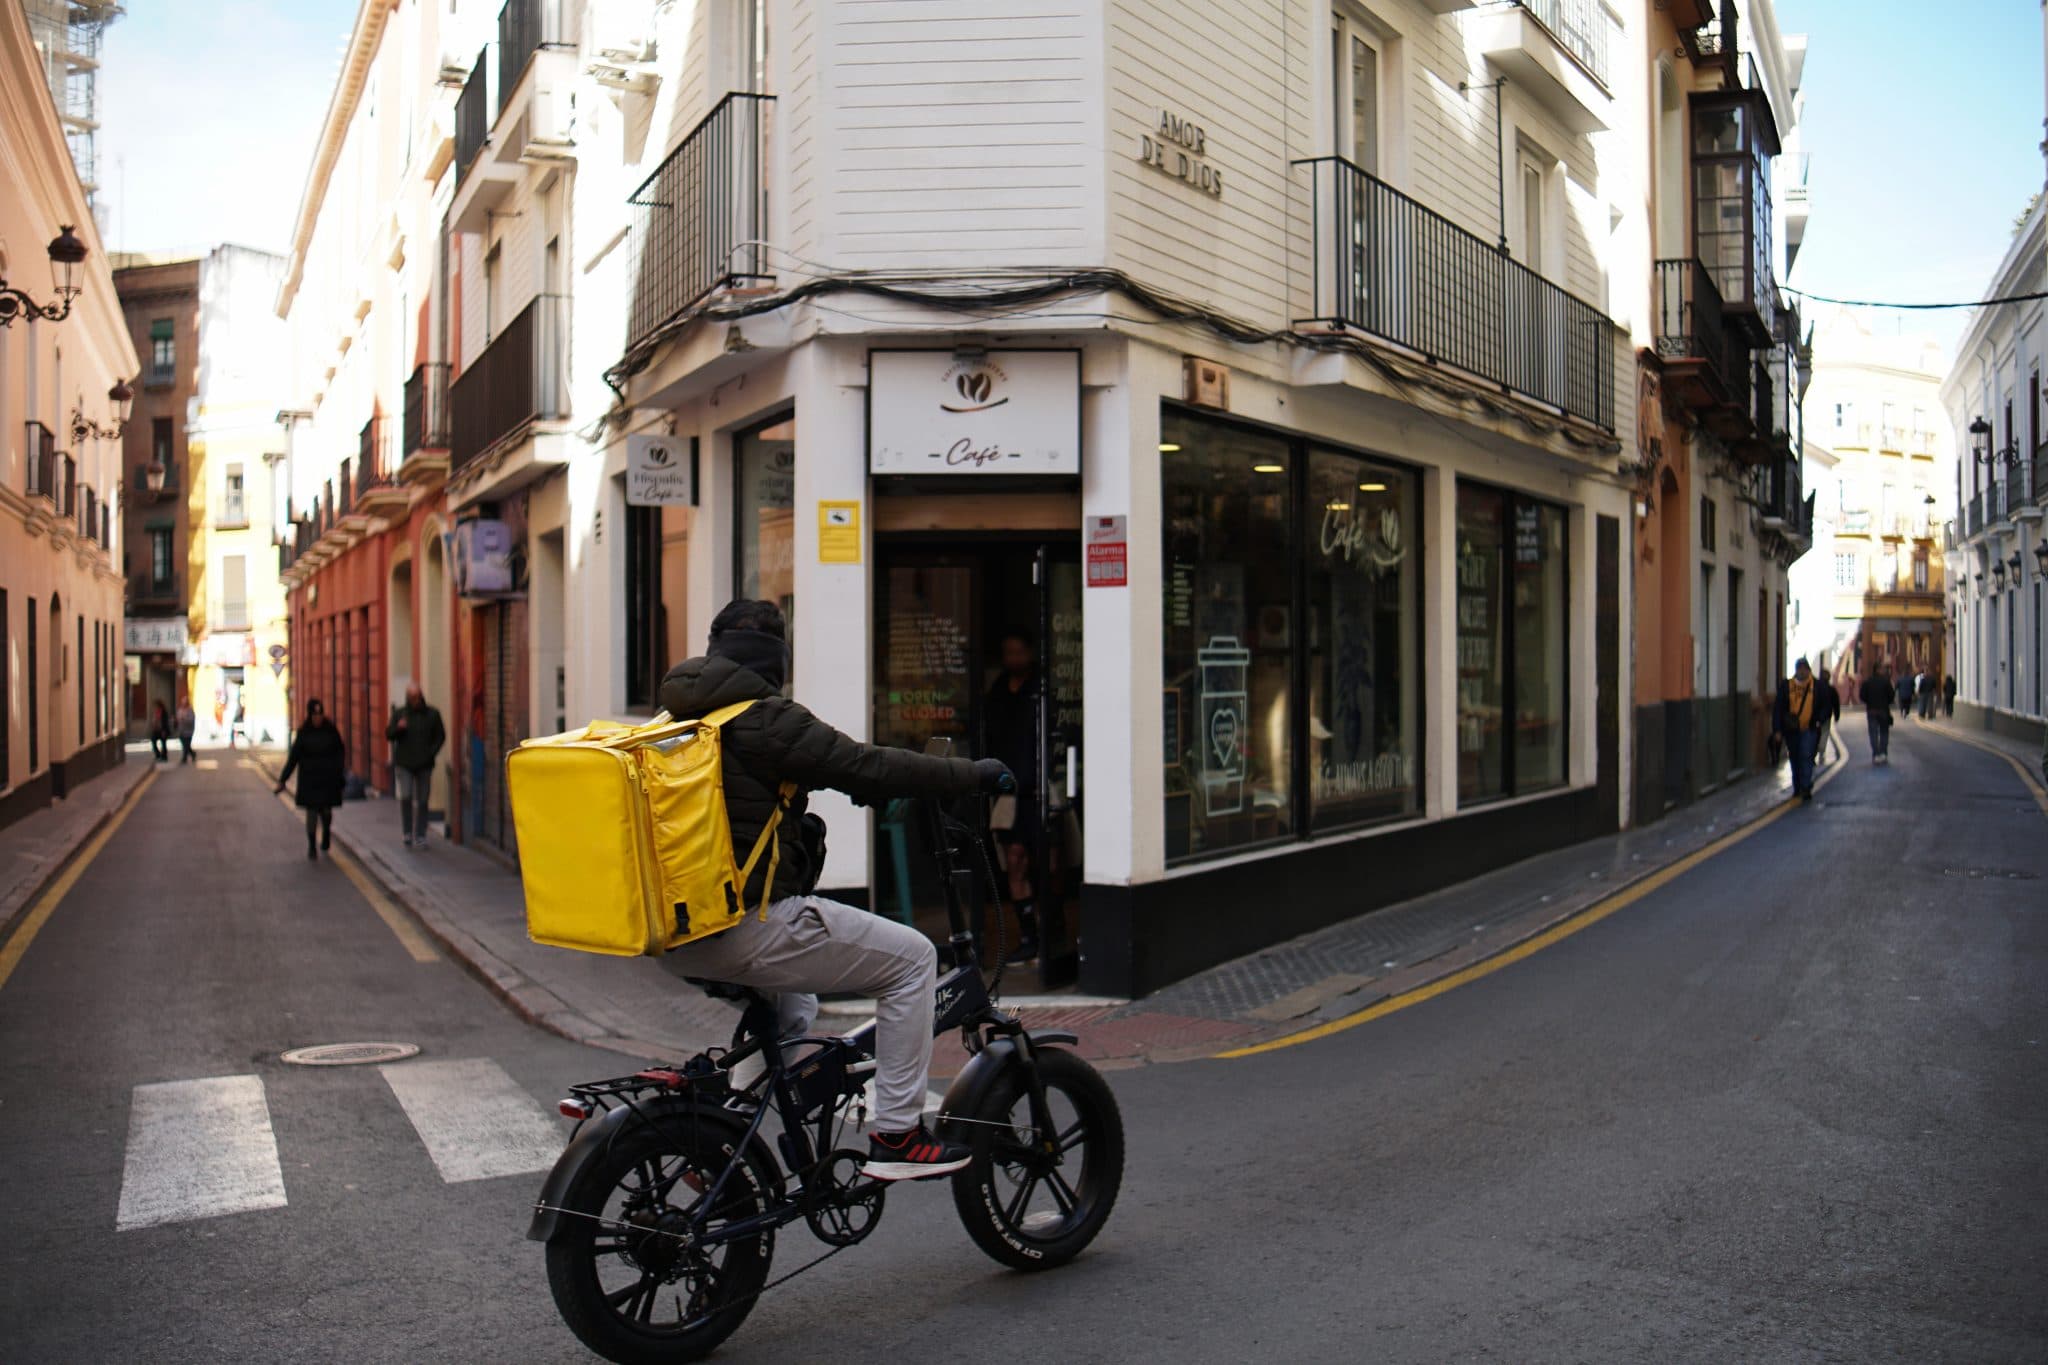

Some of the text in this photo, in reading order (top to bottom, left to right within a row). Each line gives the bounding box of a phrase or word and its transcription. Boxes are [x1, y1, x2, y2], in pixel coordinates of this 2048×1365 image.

[1158, 109, 1206, 156] AMOR
[1139, 134, 1222, 196] DE DIOS
[946, 437, 1002, 467] Café
[903, 688, 942, 704] OPEN
[903, 704, 955, 720] CLOSED
